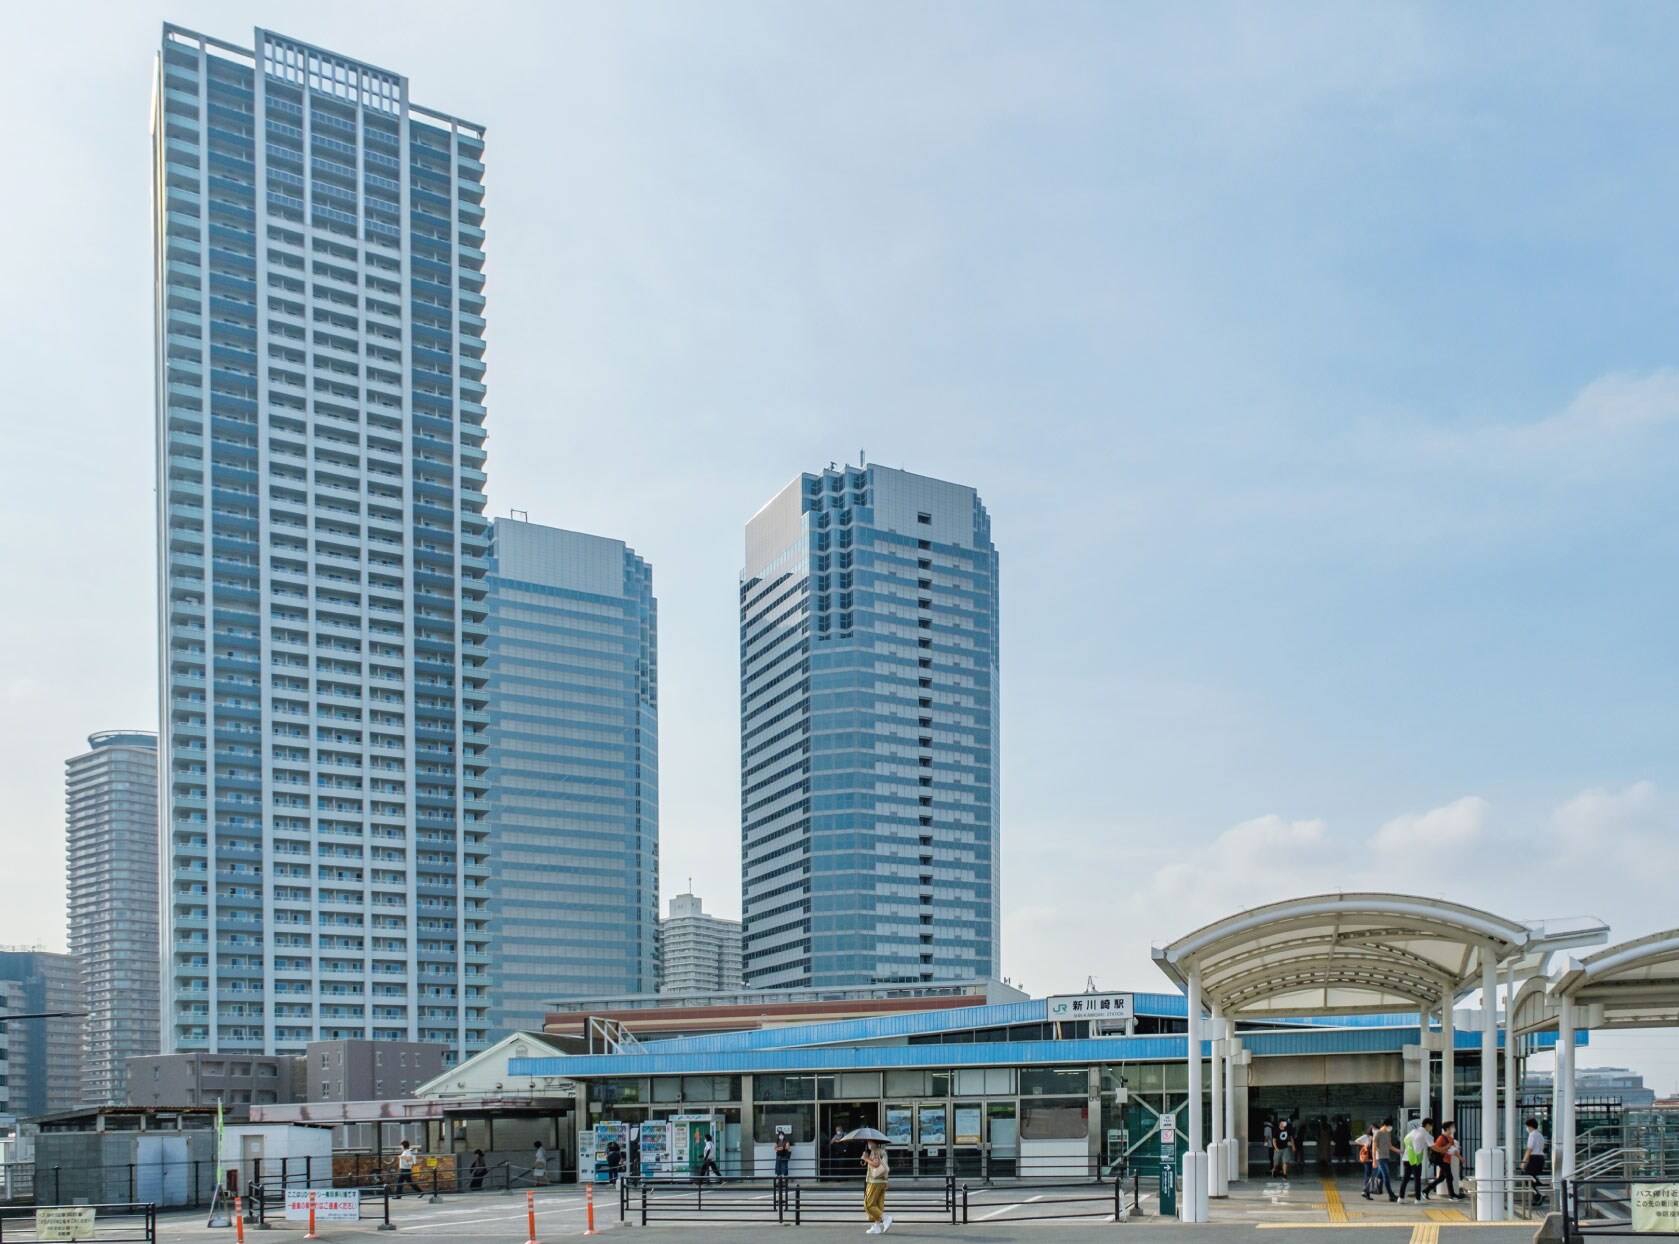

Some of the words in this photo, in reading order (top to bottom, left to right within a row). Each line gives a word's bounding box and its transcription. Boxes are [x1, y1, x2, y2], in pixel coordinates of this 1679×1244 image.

[1053, 1004, 1068, 1013] JR
[1072, 999, 1124, 1011] 新川崎駅
